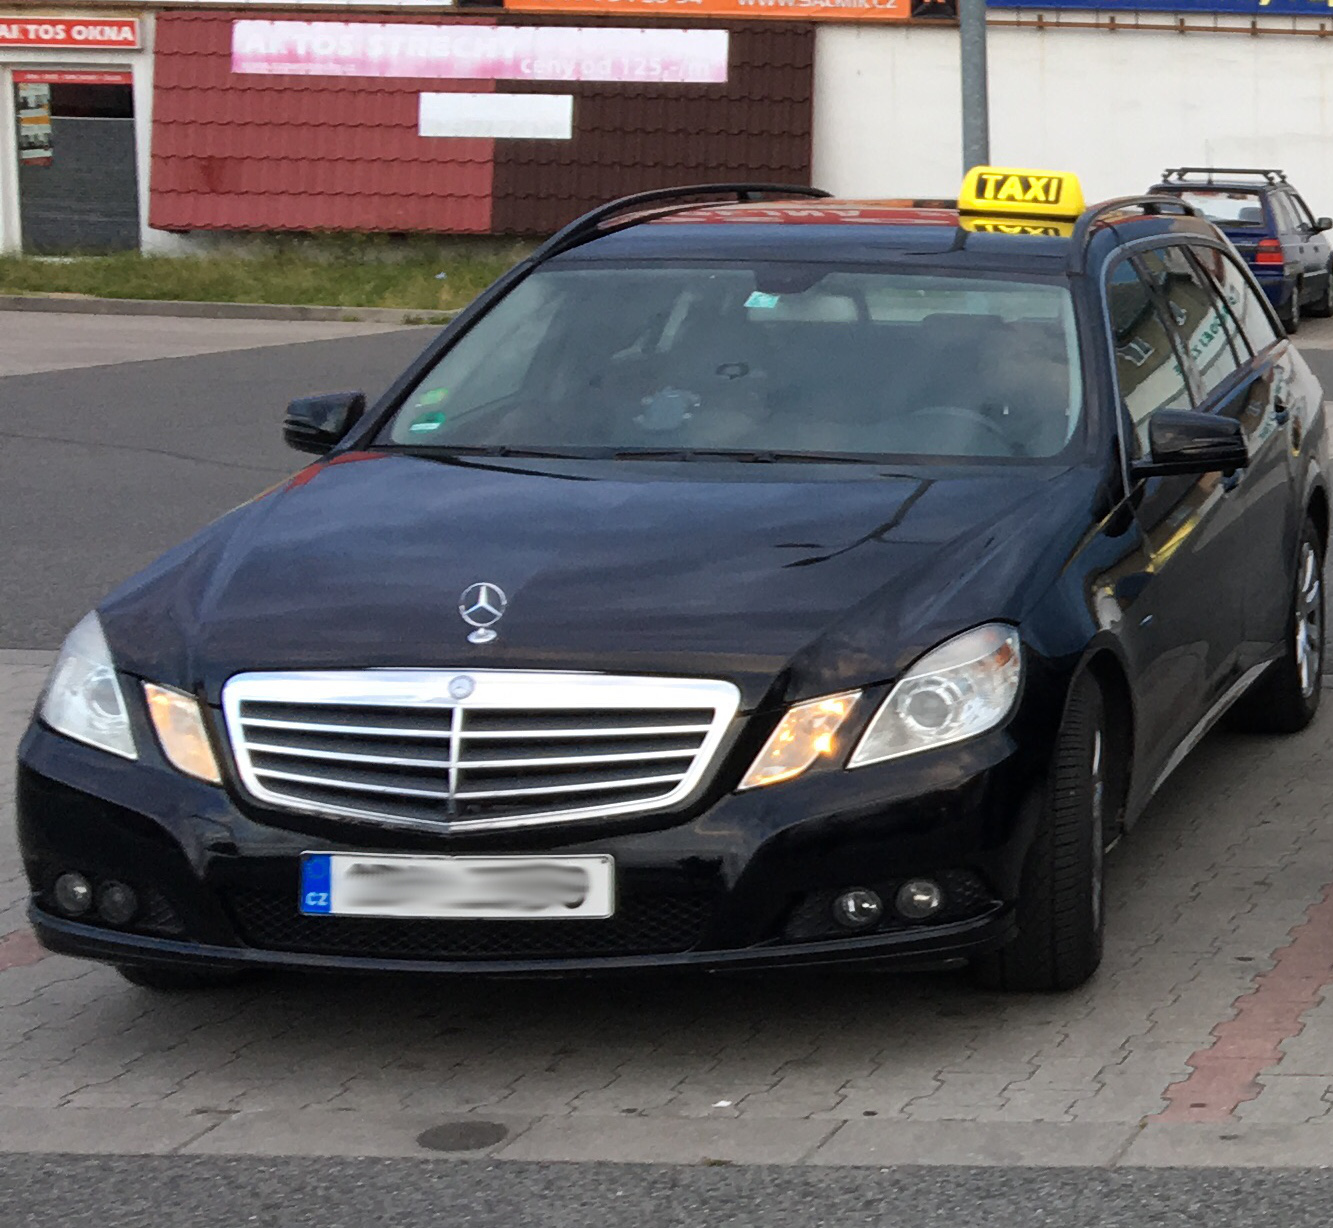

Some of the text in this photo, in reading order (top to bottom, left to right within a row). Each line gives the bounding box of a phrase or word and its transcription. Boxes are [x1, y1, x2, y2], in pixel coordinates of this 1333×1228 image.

[71, 25, 134, 41] OKNA
[981, 174, 1059, 201] TAXI
[305, 892, 328, 906] CZ
